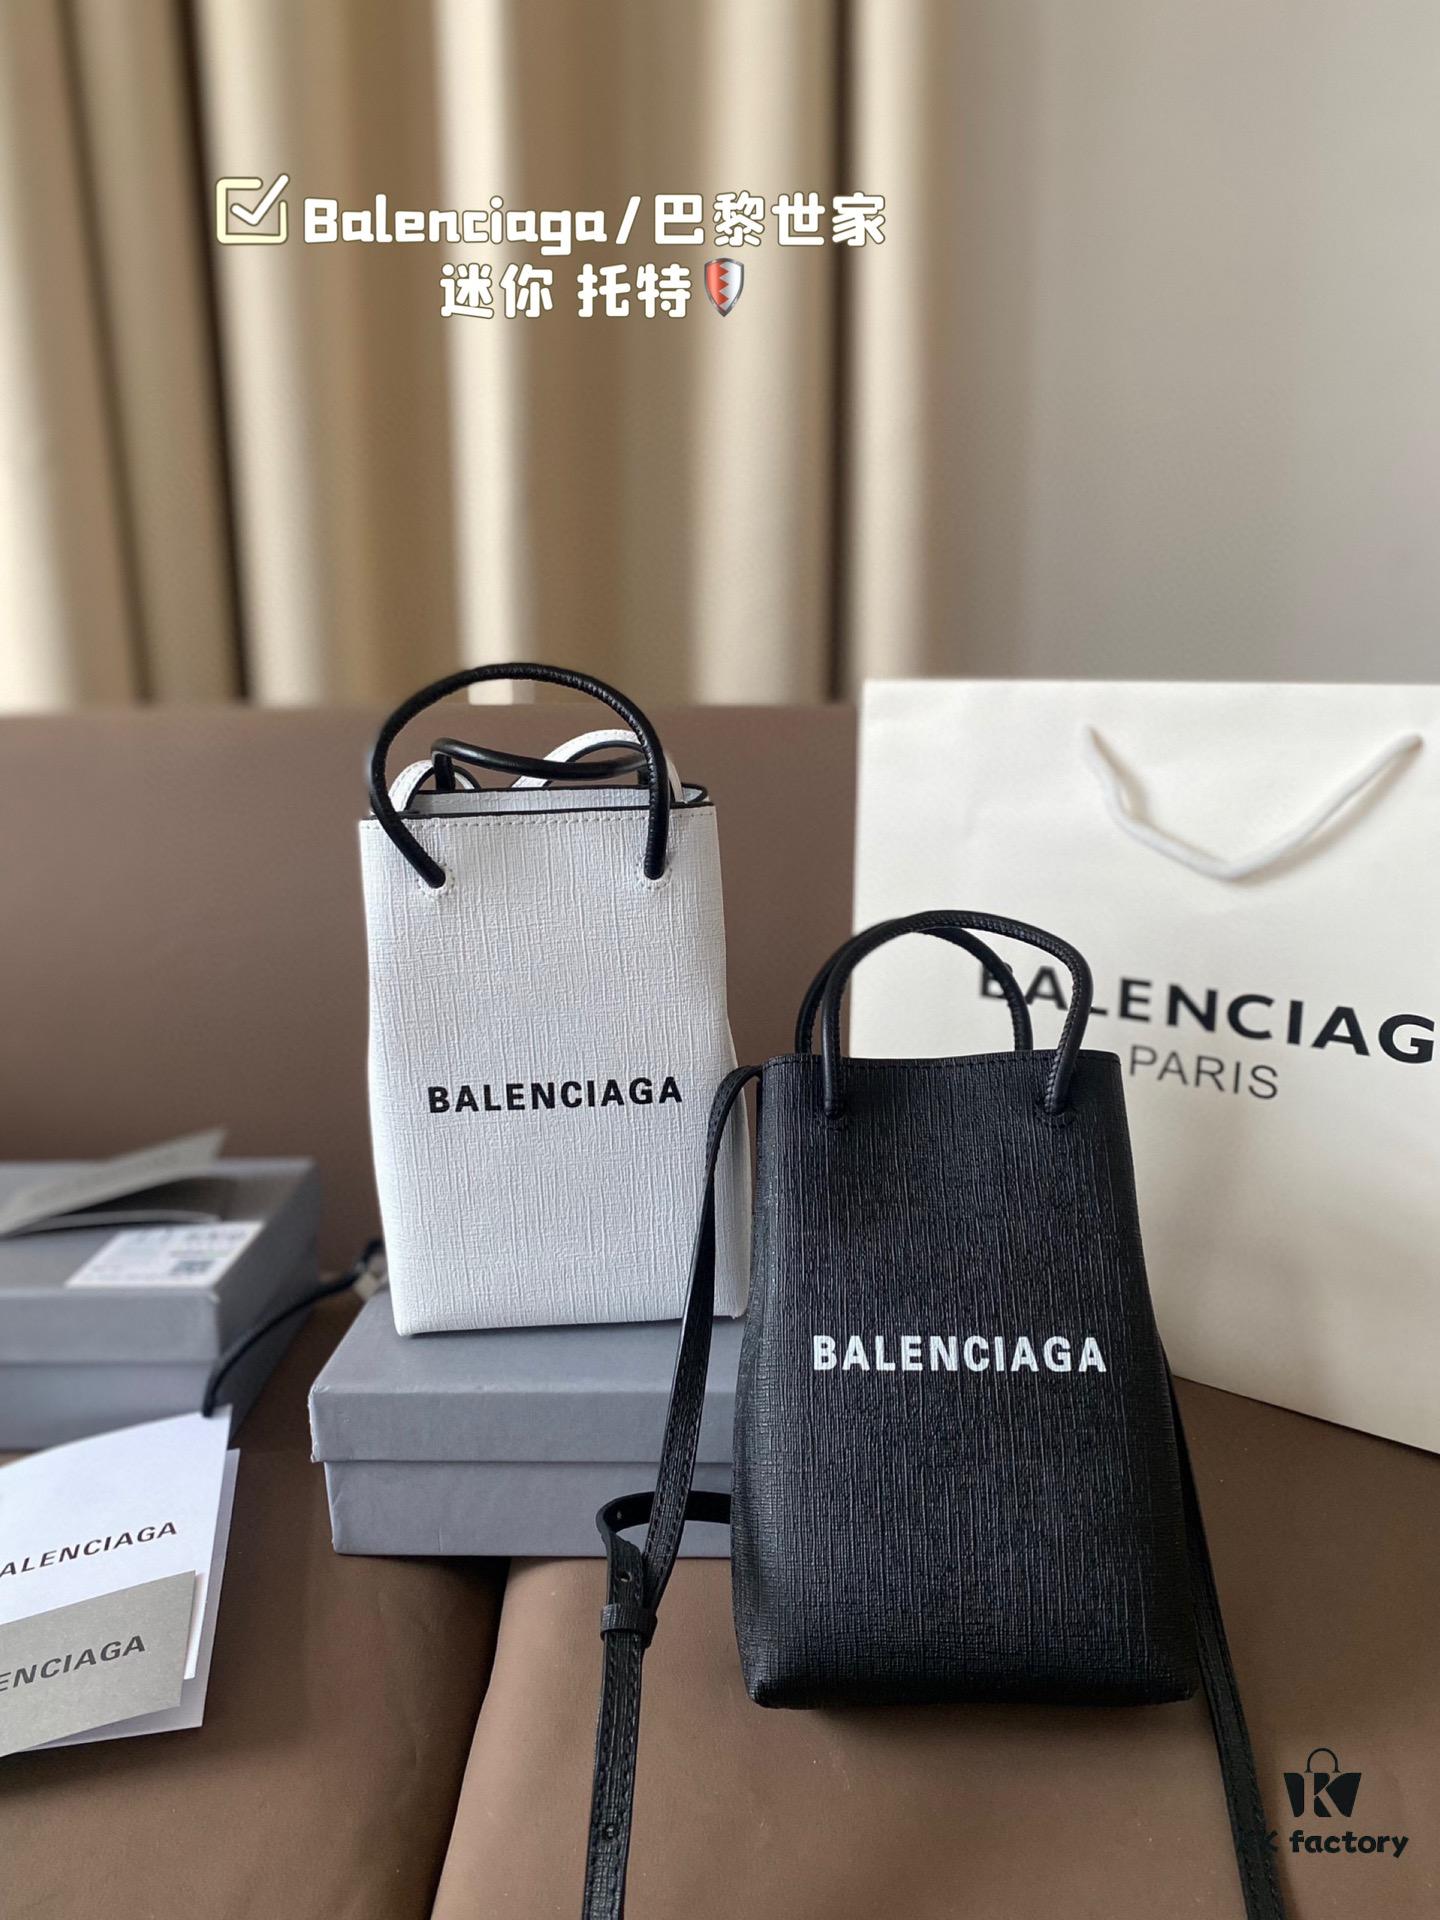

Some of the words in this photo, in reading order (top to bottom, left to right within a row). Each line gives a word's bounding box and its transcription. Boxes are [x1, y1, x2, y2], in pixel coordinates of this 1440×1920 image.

[979, 962, 1436, 1064] AENCIAG
[428, 1076, 683, 1113] BALENCIAGA
[1129, 1045, 1279, 1100] PARIS
[813, 1335, 1107, 1372] BALENCIAGA
